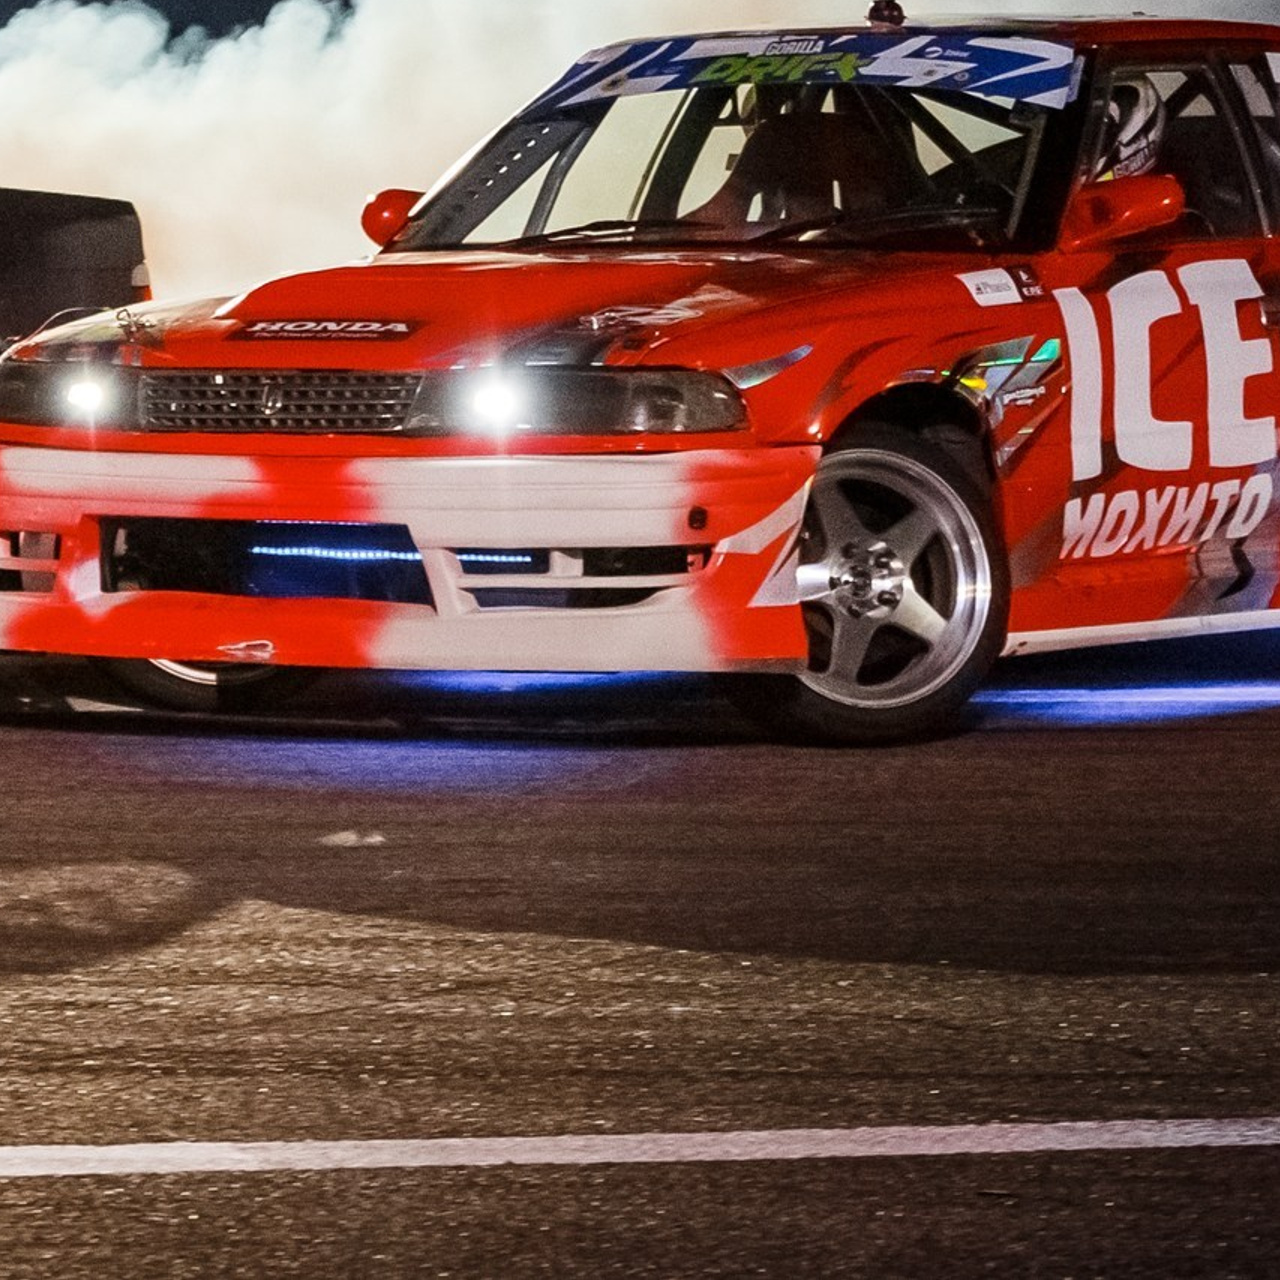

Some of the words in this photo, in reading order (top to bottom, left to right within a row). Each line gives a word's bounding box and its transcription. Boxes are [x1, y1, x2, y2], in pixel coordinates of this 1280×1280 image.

[766, 39, 825, 56] GORILLA
[246, 321, 410, 332] HONDA
[1051, 258, 1278, 483] ICE
